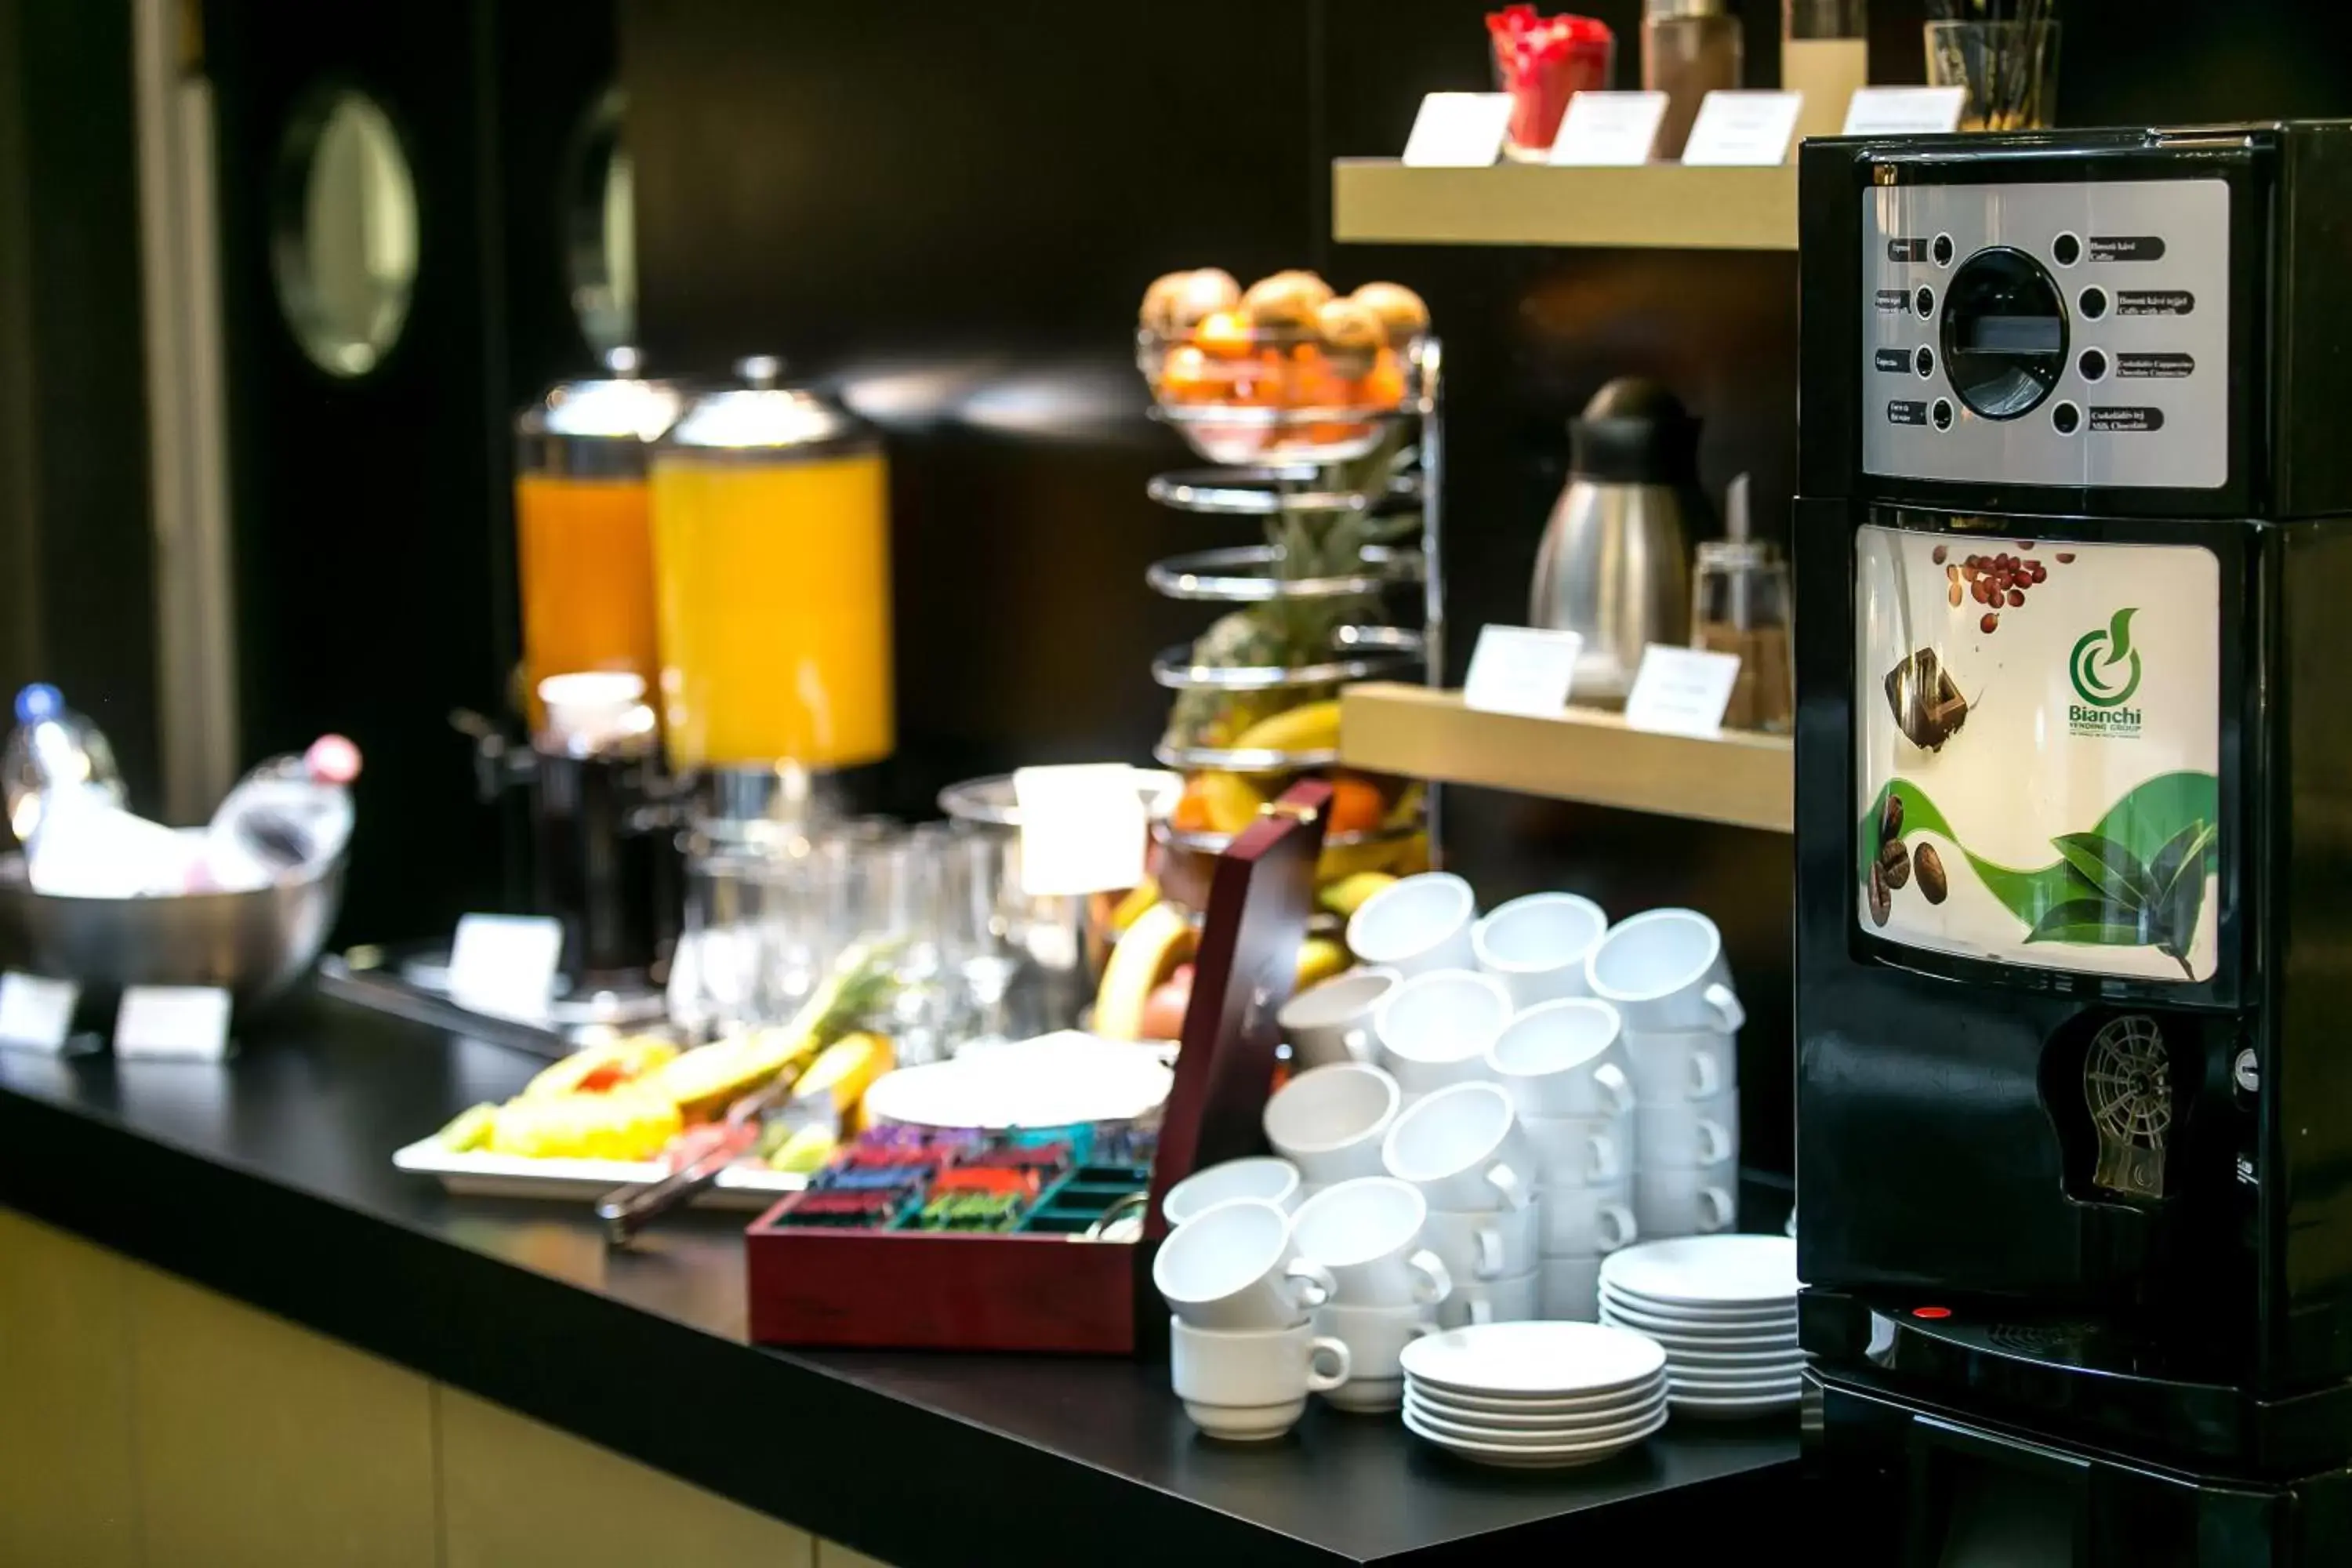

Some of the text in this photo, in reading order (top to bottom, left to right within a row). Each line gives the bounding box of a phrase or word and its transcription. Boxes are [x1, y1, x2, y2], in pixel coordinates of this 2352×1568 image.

[2069, 705, 2141, 724] Bianchi
[2069, 722, 2141, 732] VENDING GROUP
